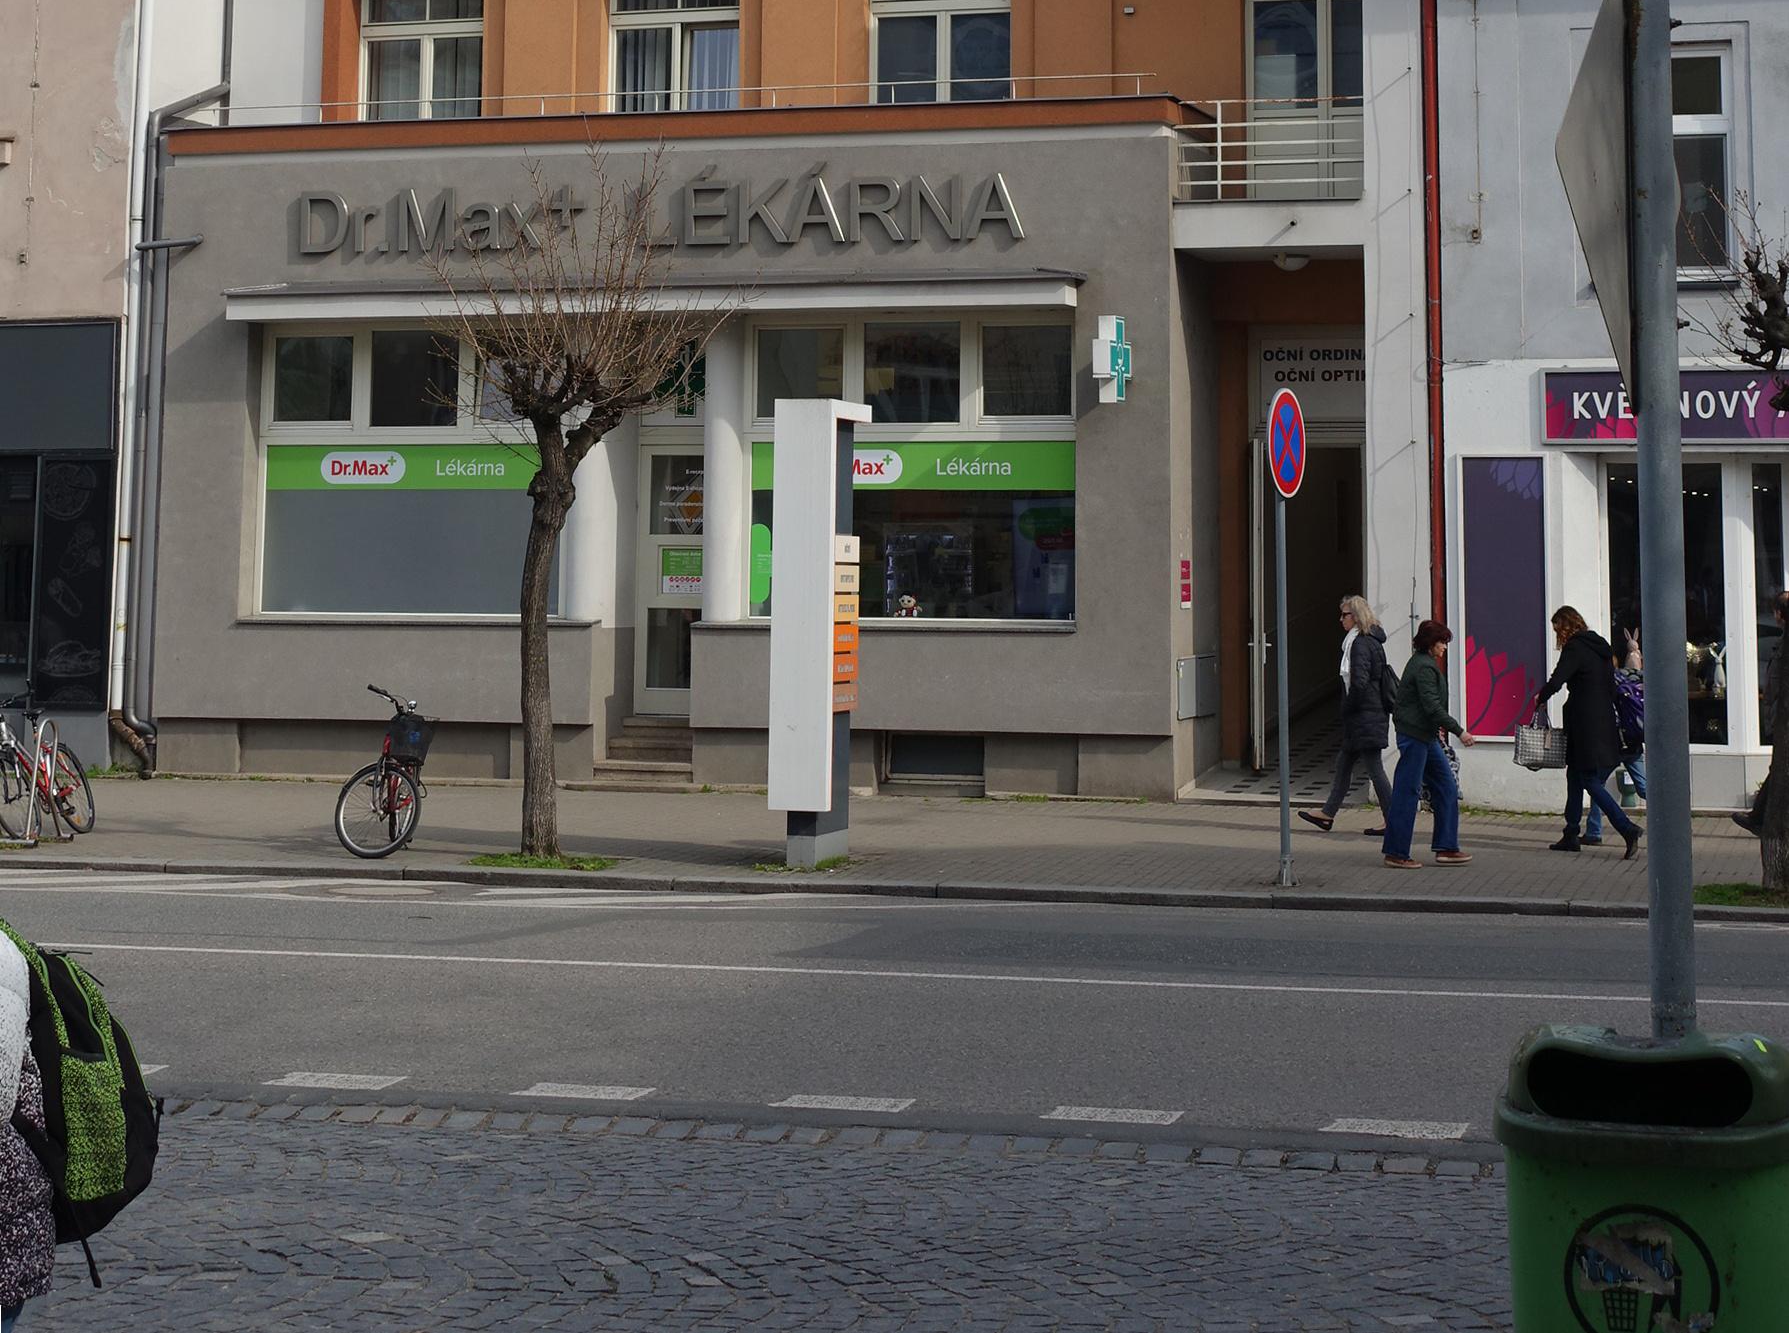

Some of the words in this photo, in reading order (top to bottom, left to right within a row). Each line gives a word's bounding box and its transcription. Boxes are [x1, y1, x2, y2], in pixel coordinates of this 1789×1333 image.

[638, 161, 1026, 246] LÉKÁRNA
[1262, 346, 1304, 362] OČNÍ
[1309, 348, 1366, 362] ORDIN
[1274, 367, 1315, 383] OČNÍ
[436, 457, 505, 477] Lékárna
[935, 456, 1012, 477] Lékárna
